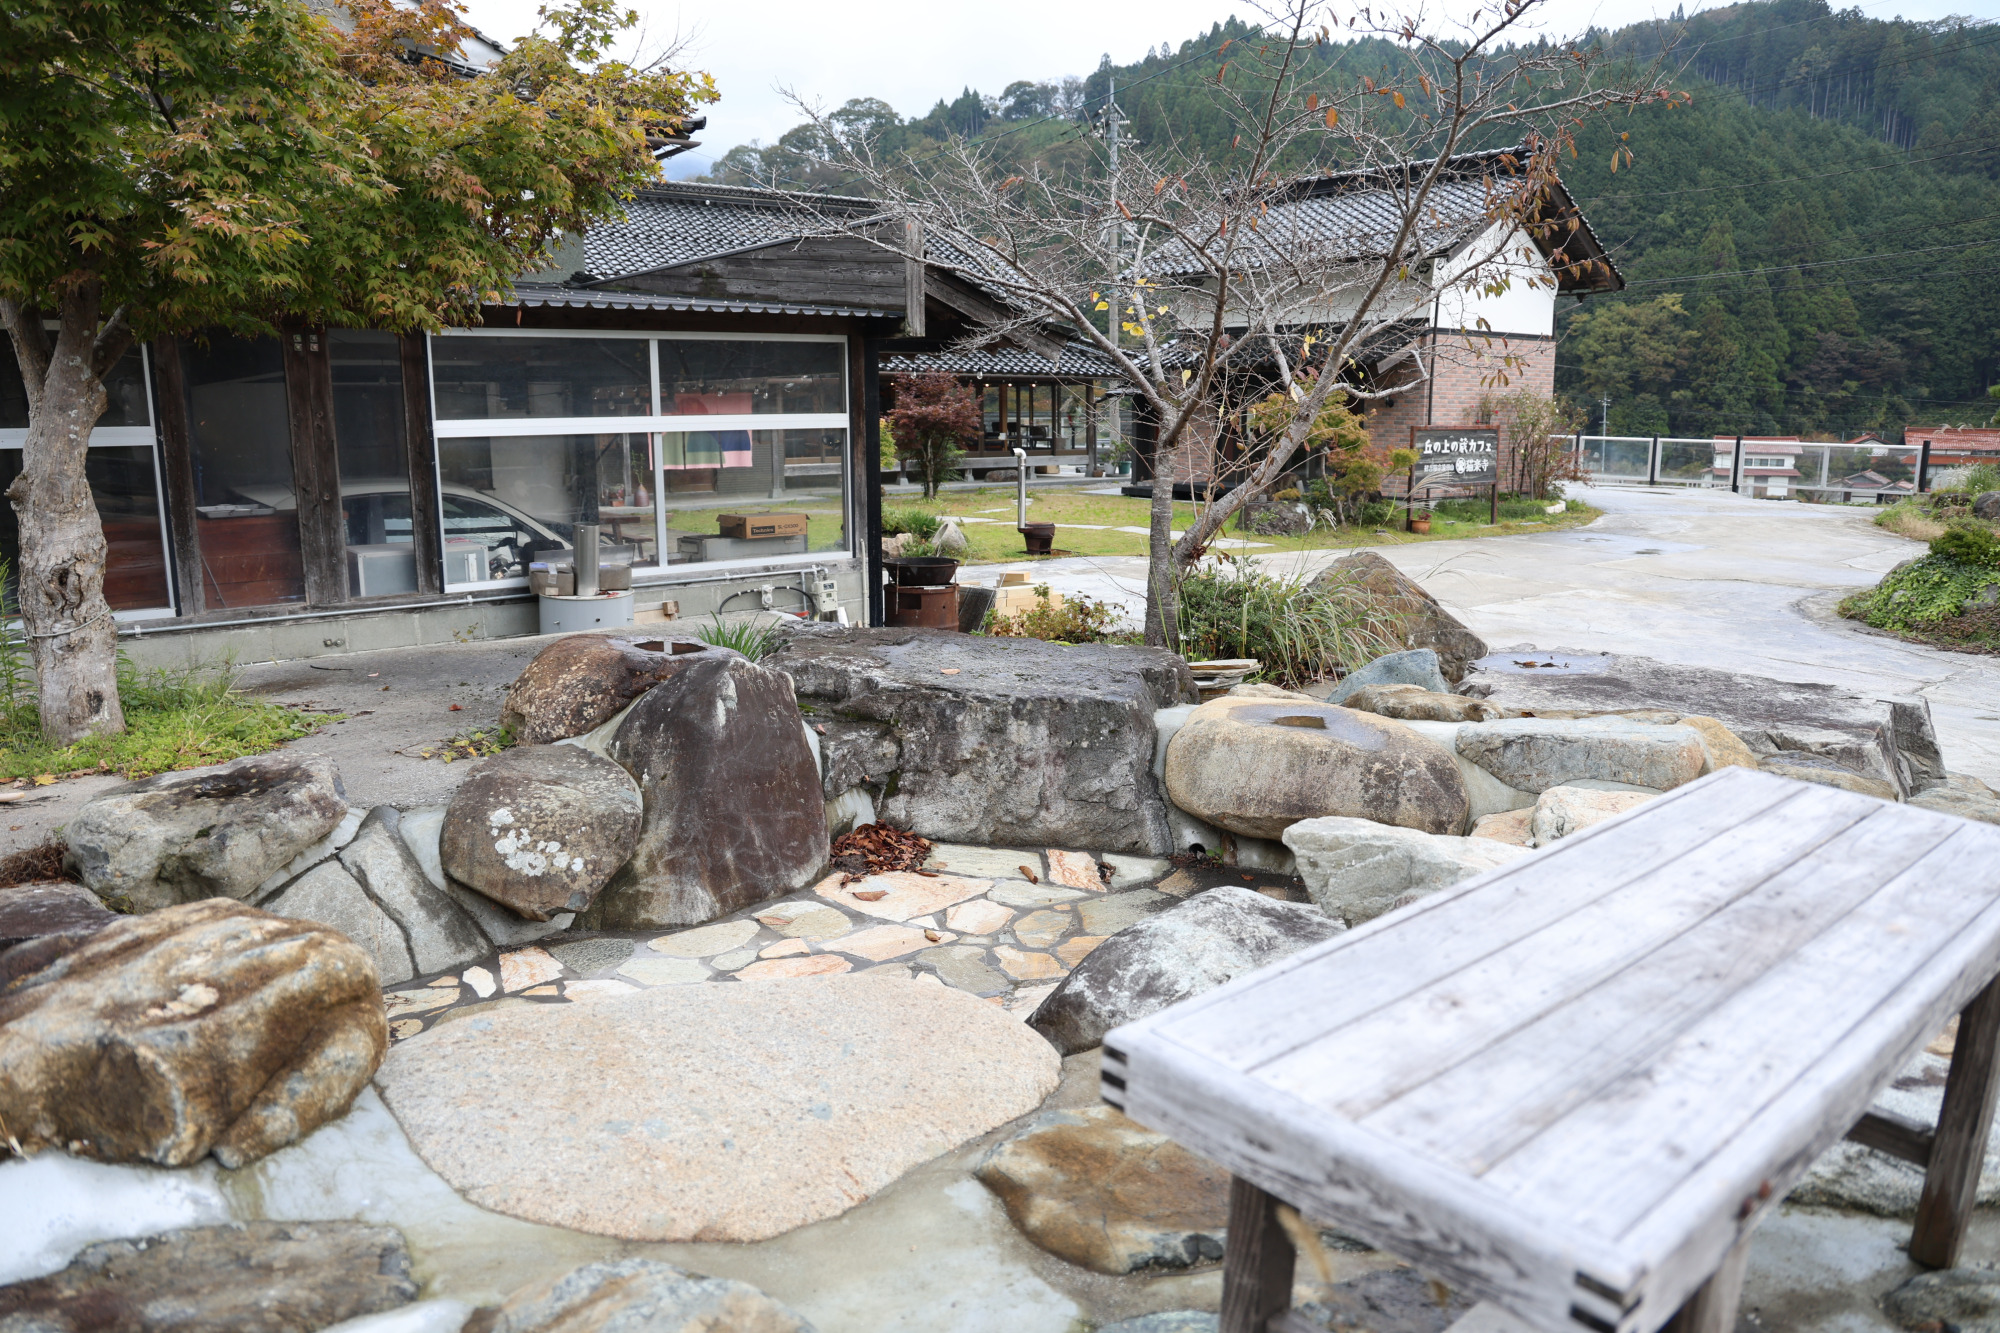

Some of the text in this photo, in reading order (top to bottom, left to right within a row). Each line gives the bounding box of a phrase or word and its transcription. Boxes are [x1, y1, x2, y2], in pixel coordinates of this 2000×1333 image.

[1423, 438, 1492, 454] 丘の上の蔵カフェ
